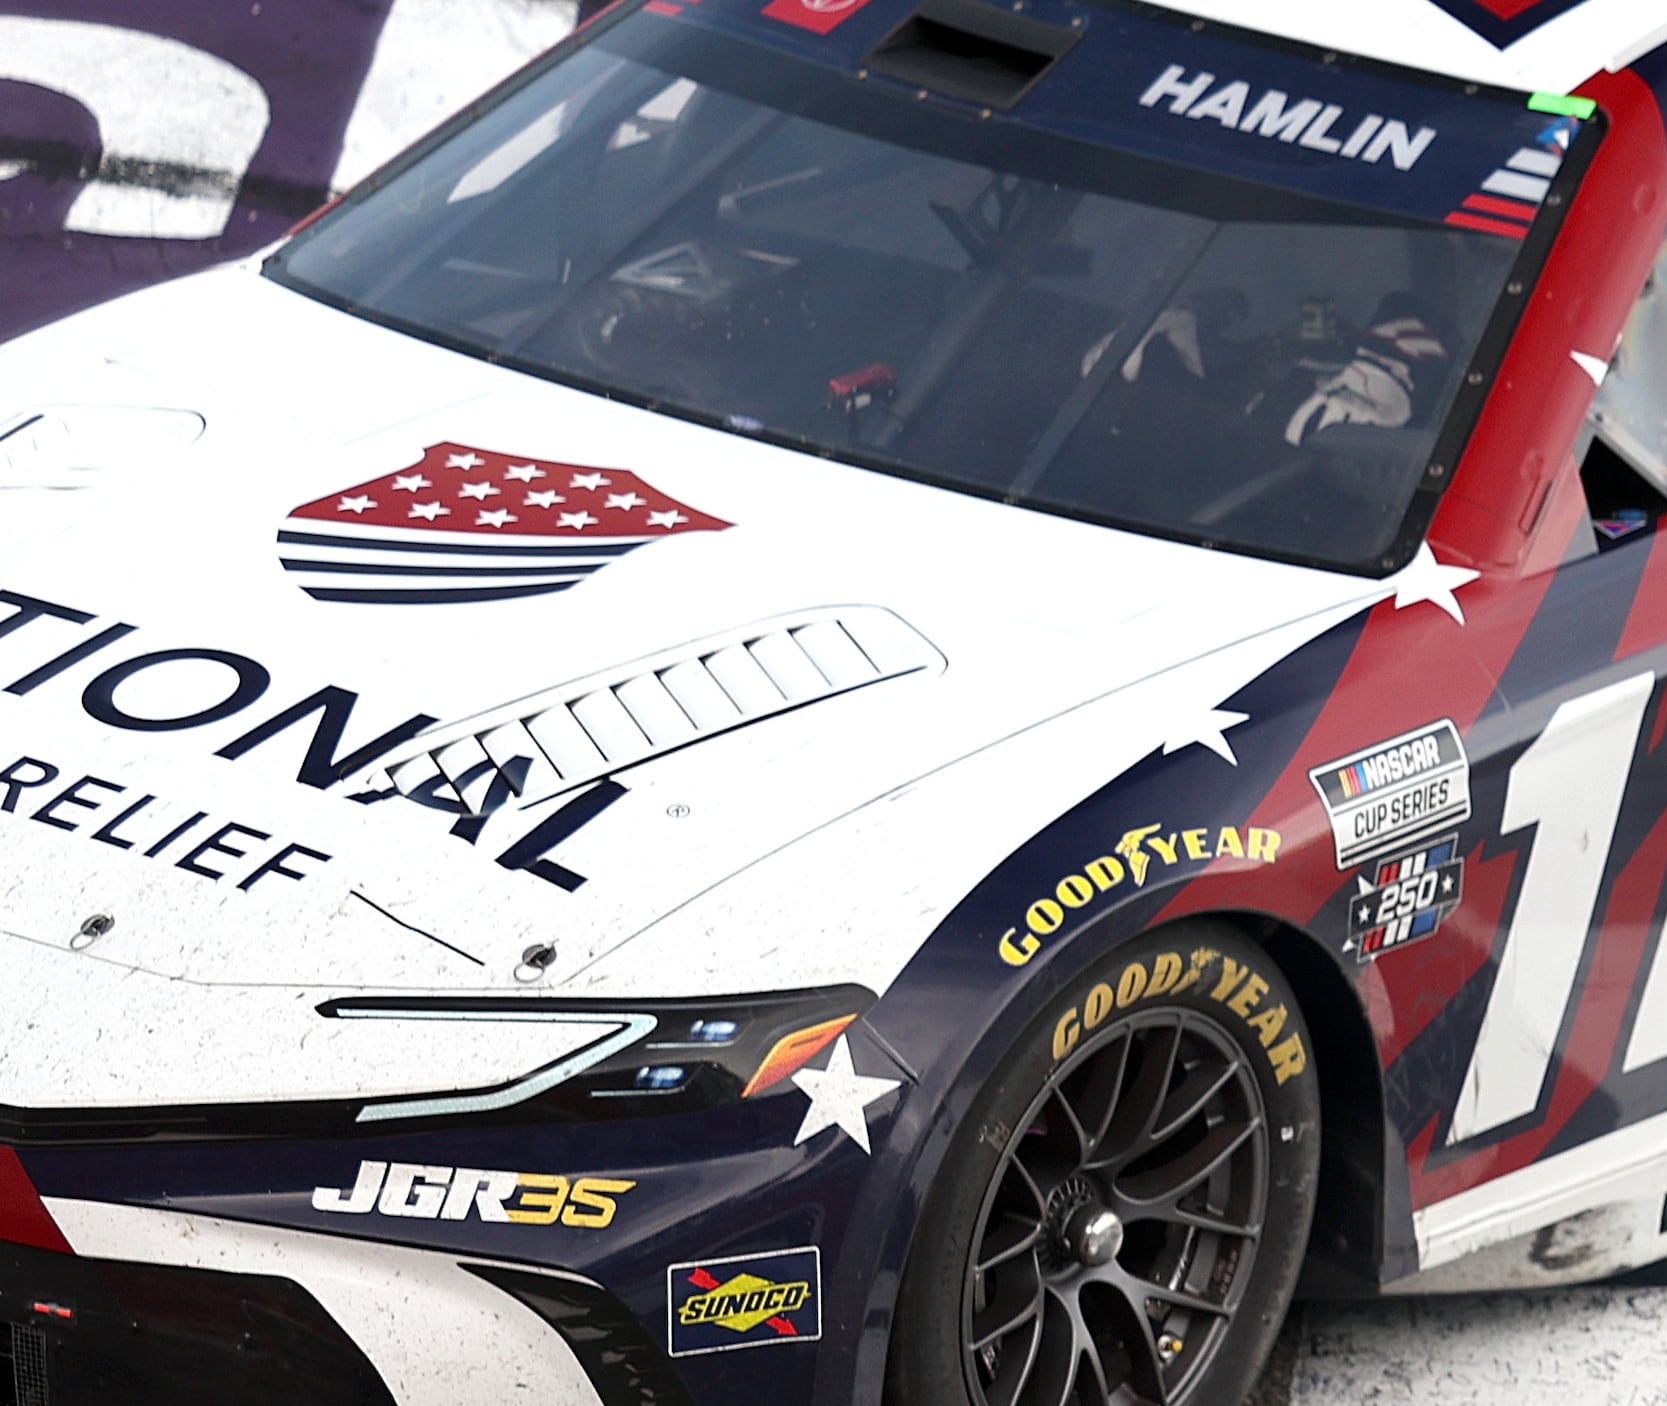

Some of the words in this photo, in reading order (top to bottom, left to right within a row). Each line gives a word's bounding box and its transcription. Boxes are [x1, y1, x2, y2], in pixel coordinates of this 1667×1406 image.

[1139, 63, 1437, 172] HAMLIN
[1361, 733, 1440, 790] NASCAR
[1352, 801, 1388, 840] CUP
[1391, 779, 1450, 831] SERIES
[997, 822, 1282, 968] GOODYEAR
[1375, 870, 1438, 922] 250
[1052, 948, 1306, 1087] GOODYEAR
[311, 1160, 637, 1229] JGR35
[684, 1282, 807, 1325] SUNOCO
